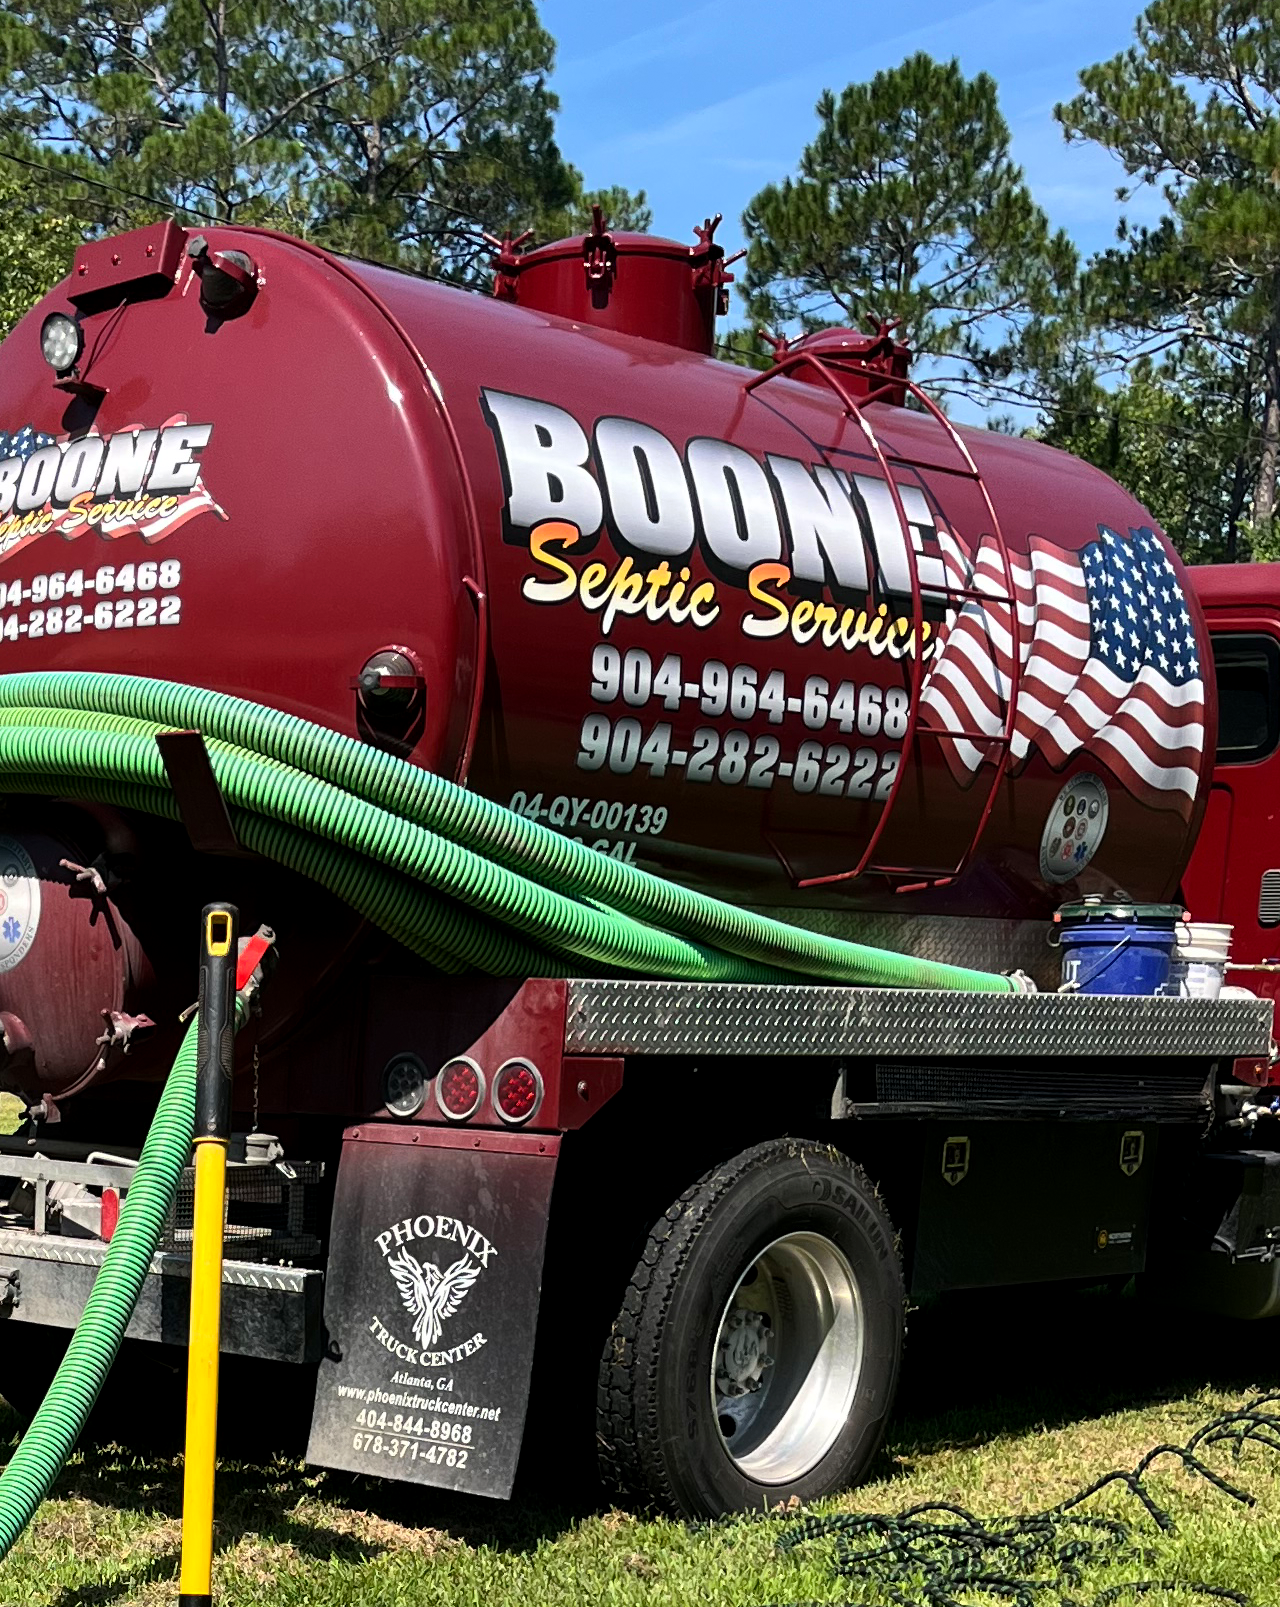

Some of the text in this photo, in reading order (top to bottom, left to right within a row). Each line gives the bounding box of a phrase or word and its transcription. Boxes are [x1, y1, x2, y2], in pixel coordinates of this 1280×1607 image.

[61, 490, 179, 531] Service
[482, 387, 949, 599] BOONE
[522, 521, 936, 662] Septic Service
[590, 643, 910, 739] 904-964-6468
[576, 713, 903, 801] 904-282-6222
[508, 790, 669, 835] 04-QY-00139
[373, 1214, 499, 1269] PHOENIX
[831, 1185, 889, 1262] SAILUN
[370, 1316, 488, 1367] TRUCK CENTER
[337, 1384, 502, 1422] www.phoenixtruckcenter.net
[390, 1370, 455, 1392] Atlanta, GA
[352, 1432, 469, 1469] 678-371-4782
[355, 1407, 473, 1444] 404-844-8968
